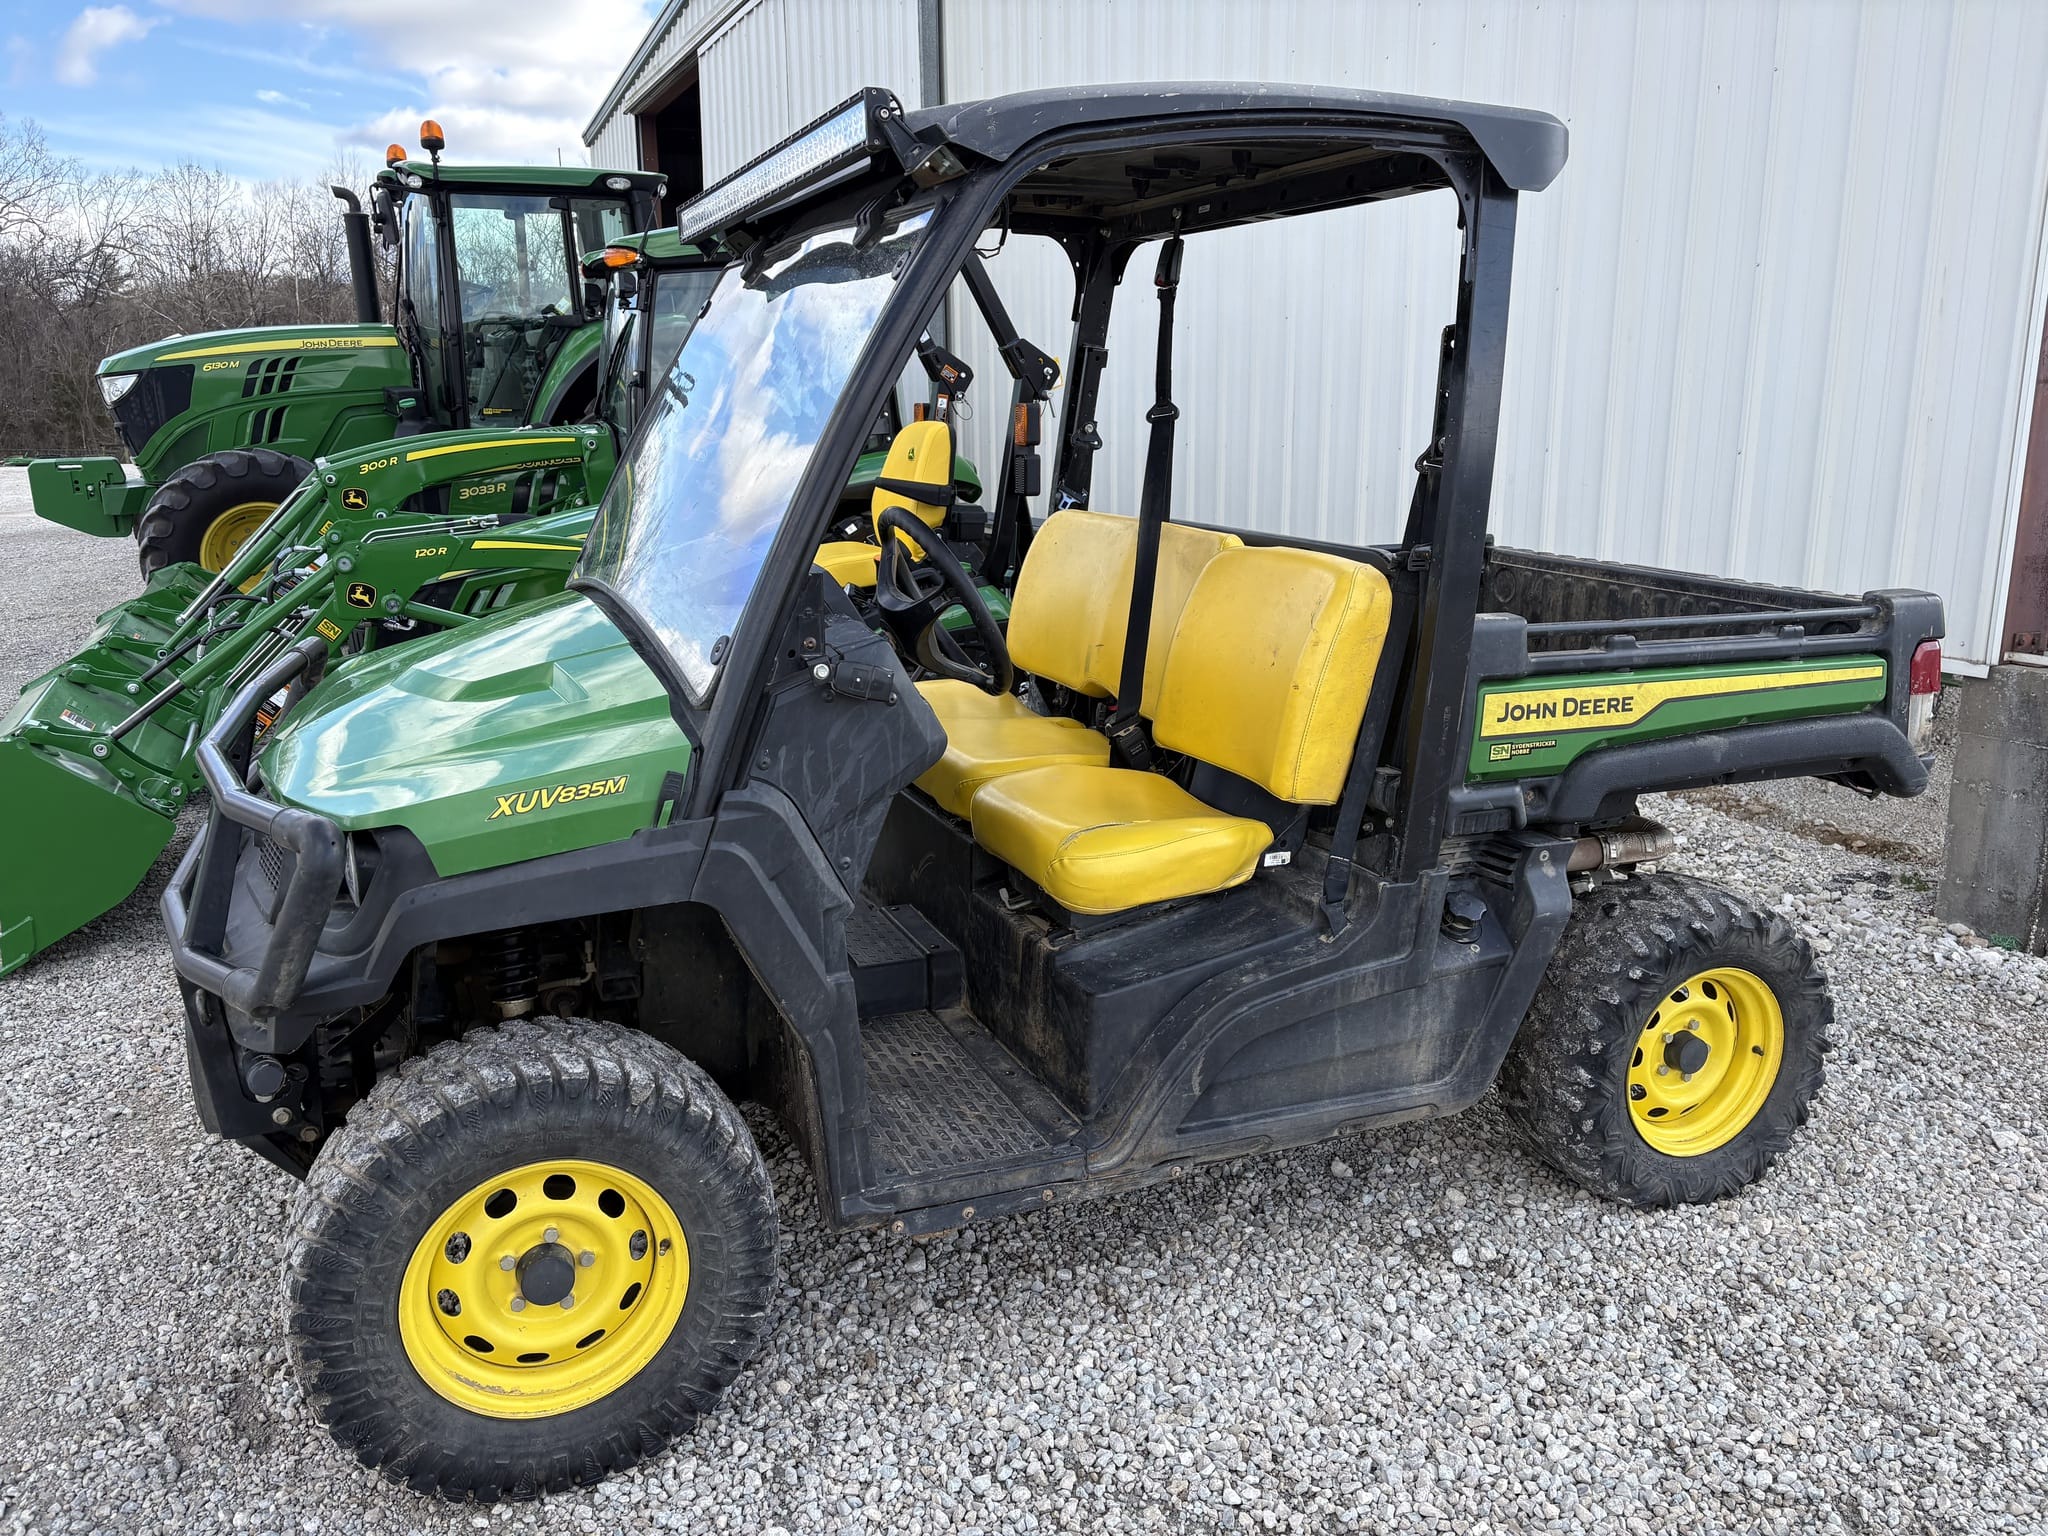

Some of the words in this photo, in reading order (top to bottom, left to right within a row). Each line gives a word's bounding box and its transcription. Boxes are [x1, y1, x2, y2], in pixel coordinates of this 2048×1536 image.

[300, 340, 328, 349] JOHN
[329, 339, 362, 347] DEERE
[202, 361, 229, 372] 6130
[229, 360, 240, 369] M
[359, 459, 388, 475] 300
[389, 456, 398, 466] R
[459, 484, 496, 500] 3033
[496, 482, 506, 493] R
[415, 548, 437, 559] 120
[437, 547, 448, 555] R
[1496, 702, 1558, 723] JOHN
[1562, 696, 1634, 717] DEERE
[1492, 745, 1510, 756] SN
[486, 775, 630, 821] XUV835M
